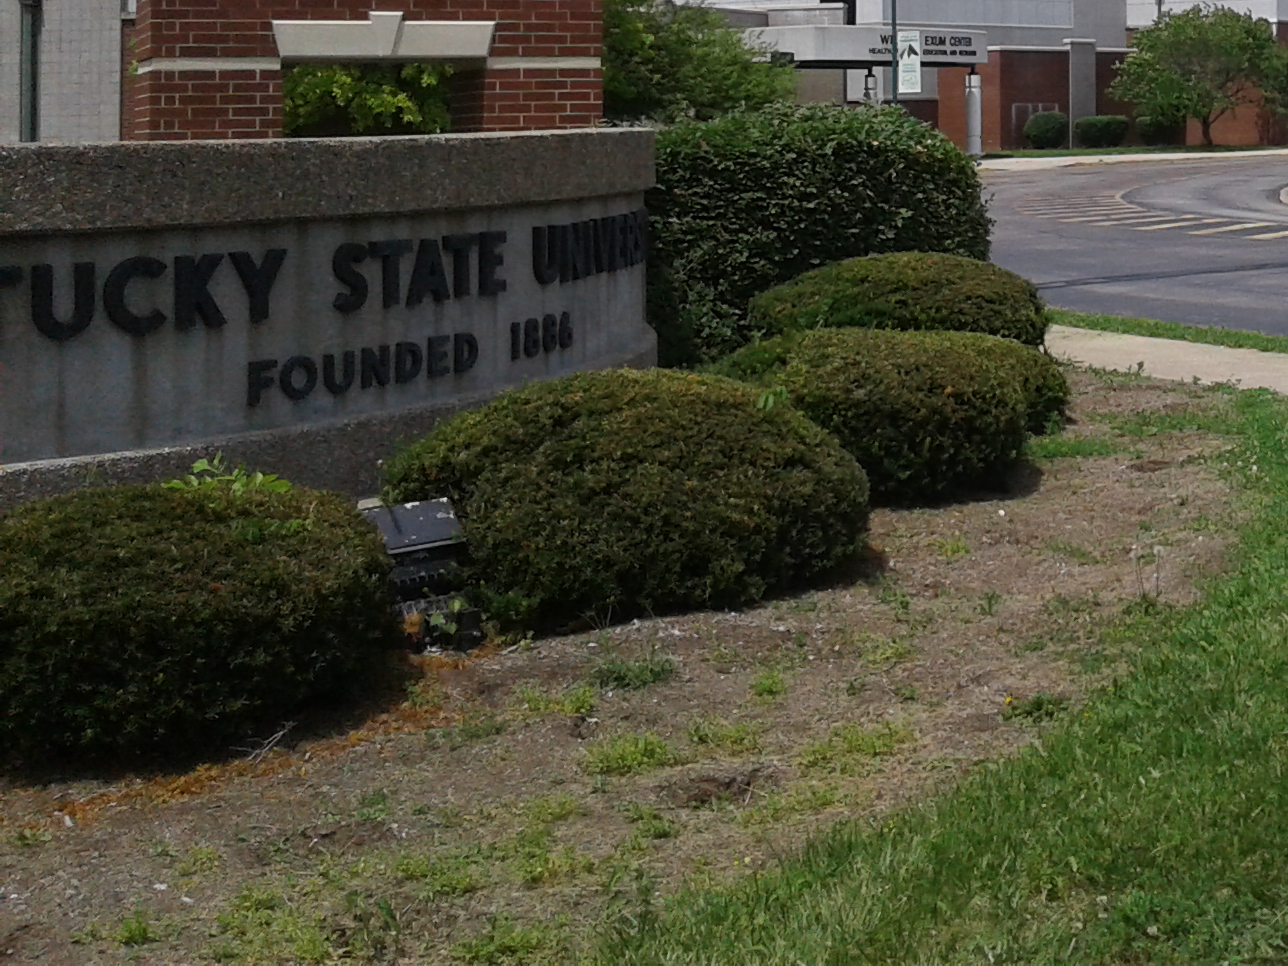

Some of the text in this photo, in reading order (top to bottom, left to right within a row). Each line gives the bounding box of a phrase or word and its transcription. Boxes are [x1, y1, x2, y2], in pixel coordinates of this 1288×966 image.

[924, 35, 947, 46] EXUM
[332, 231, 507, 315] STATE
[247, 310, 574, 408] FOUNDED 1886
